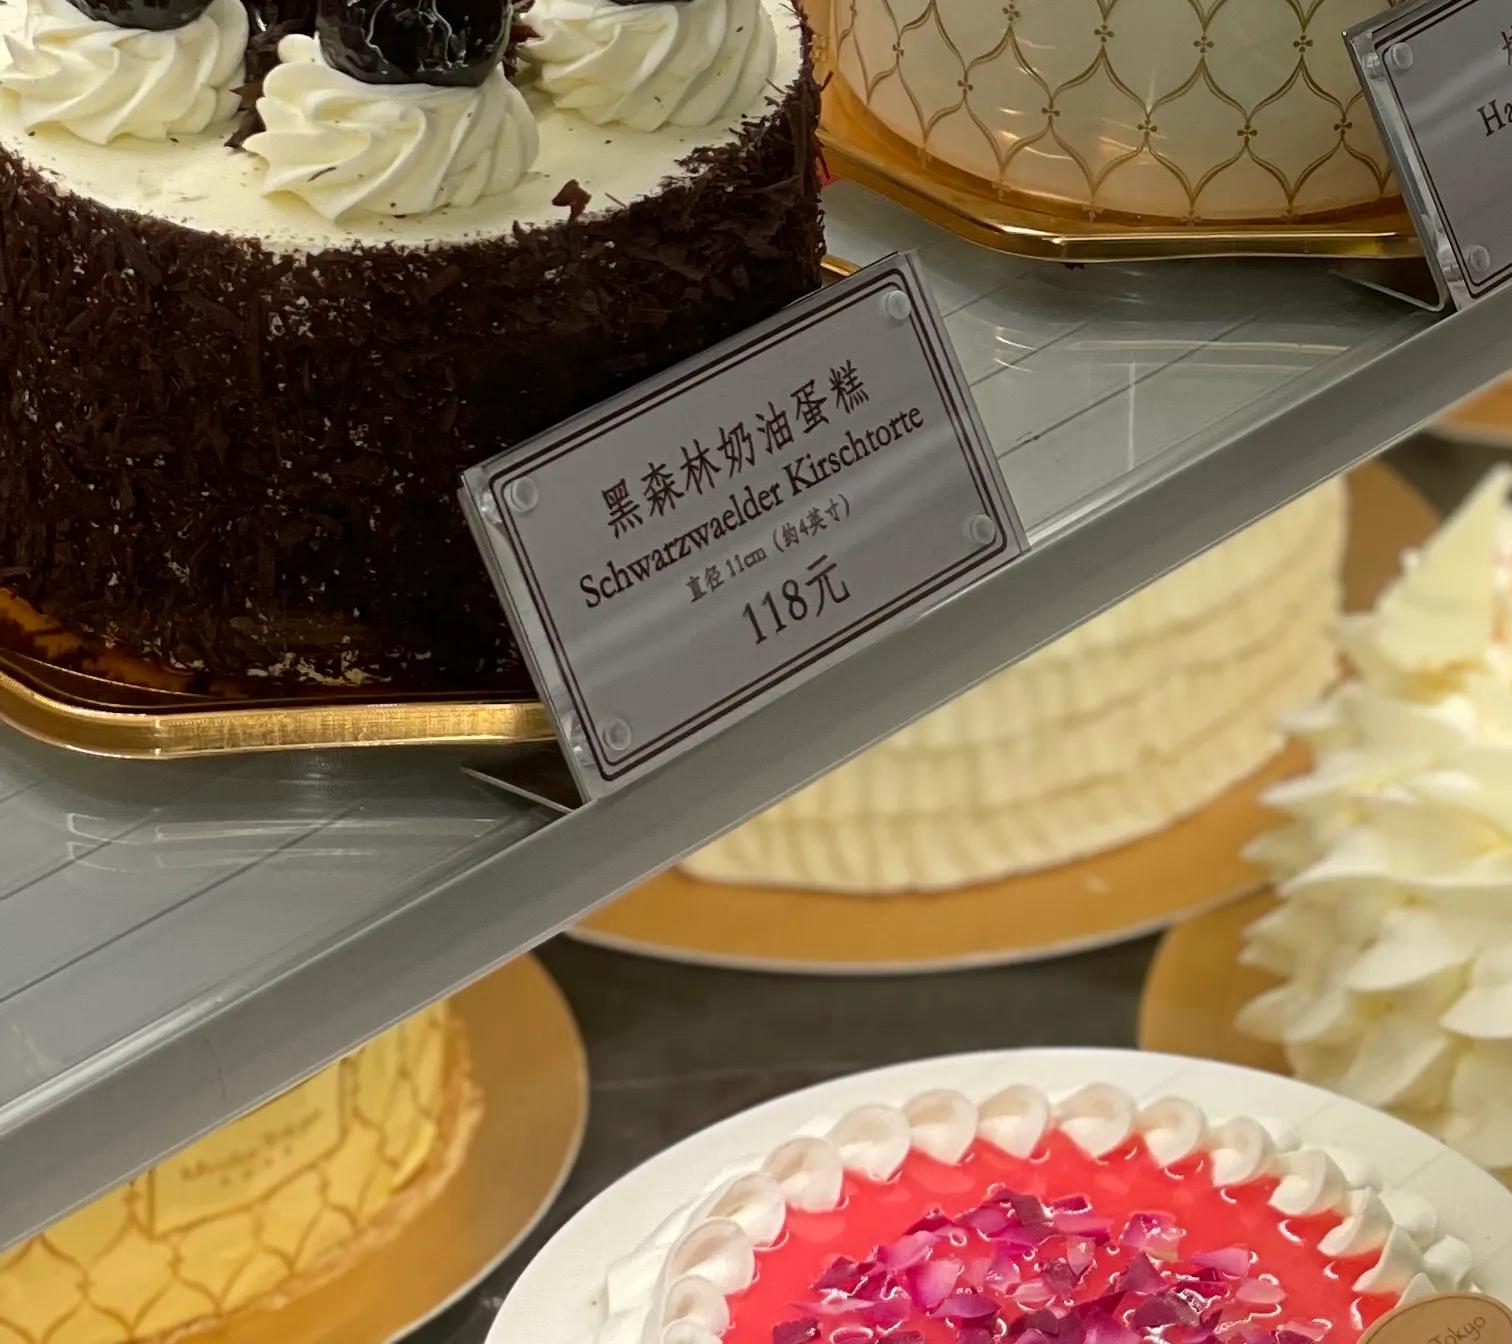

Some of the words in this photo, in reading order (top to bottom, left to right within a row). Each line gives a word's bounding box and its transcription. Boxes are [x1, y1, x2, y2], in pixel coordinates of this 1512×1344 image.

[579, 484, 783, 608] Schwarzwaelder
[783, 403, 924, 497] Kirschtorte
[601, 359, 870, 539] 黑森林奶油蛋糕
[741, 554, 850, 645] 118元
